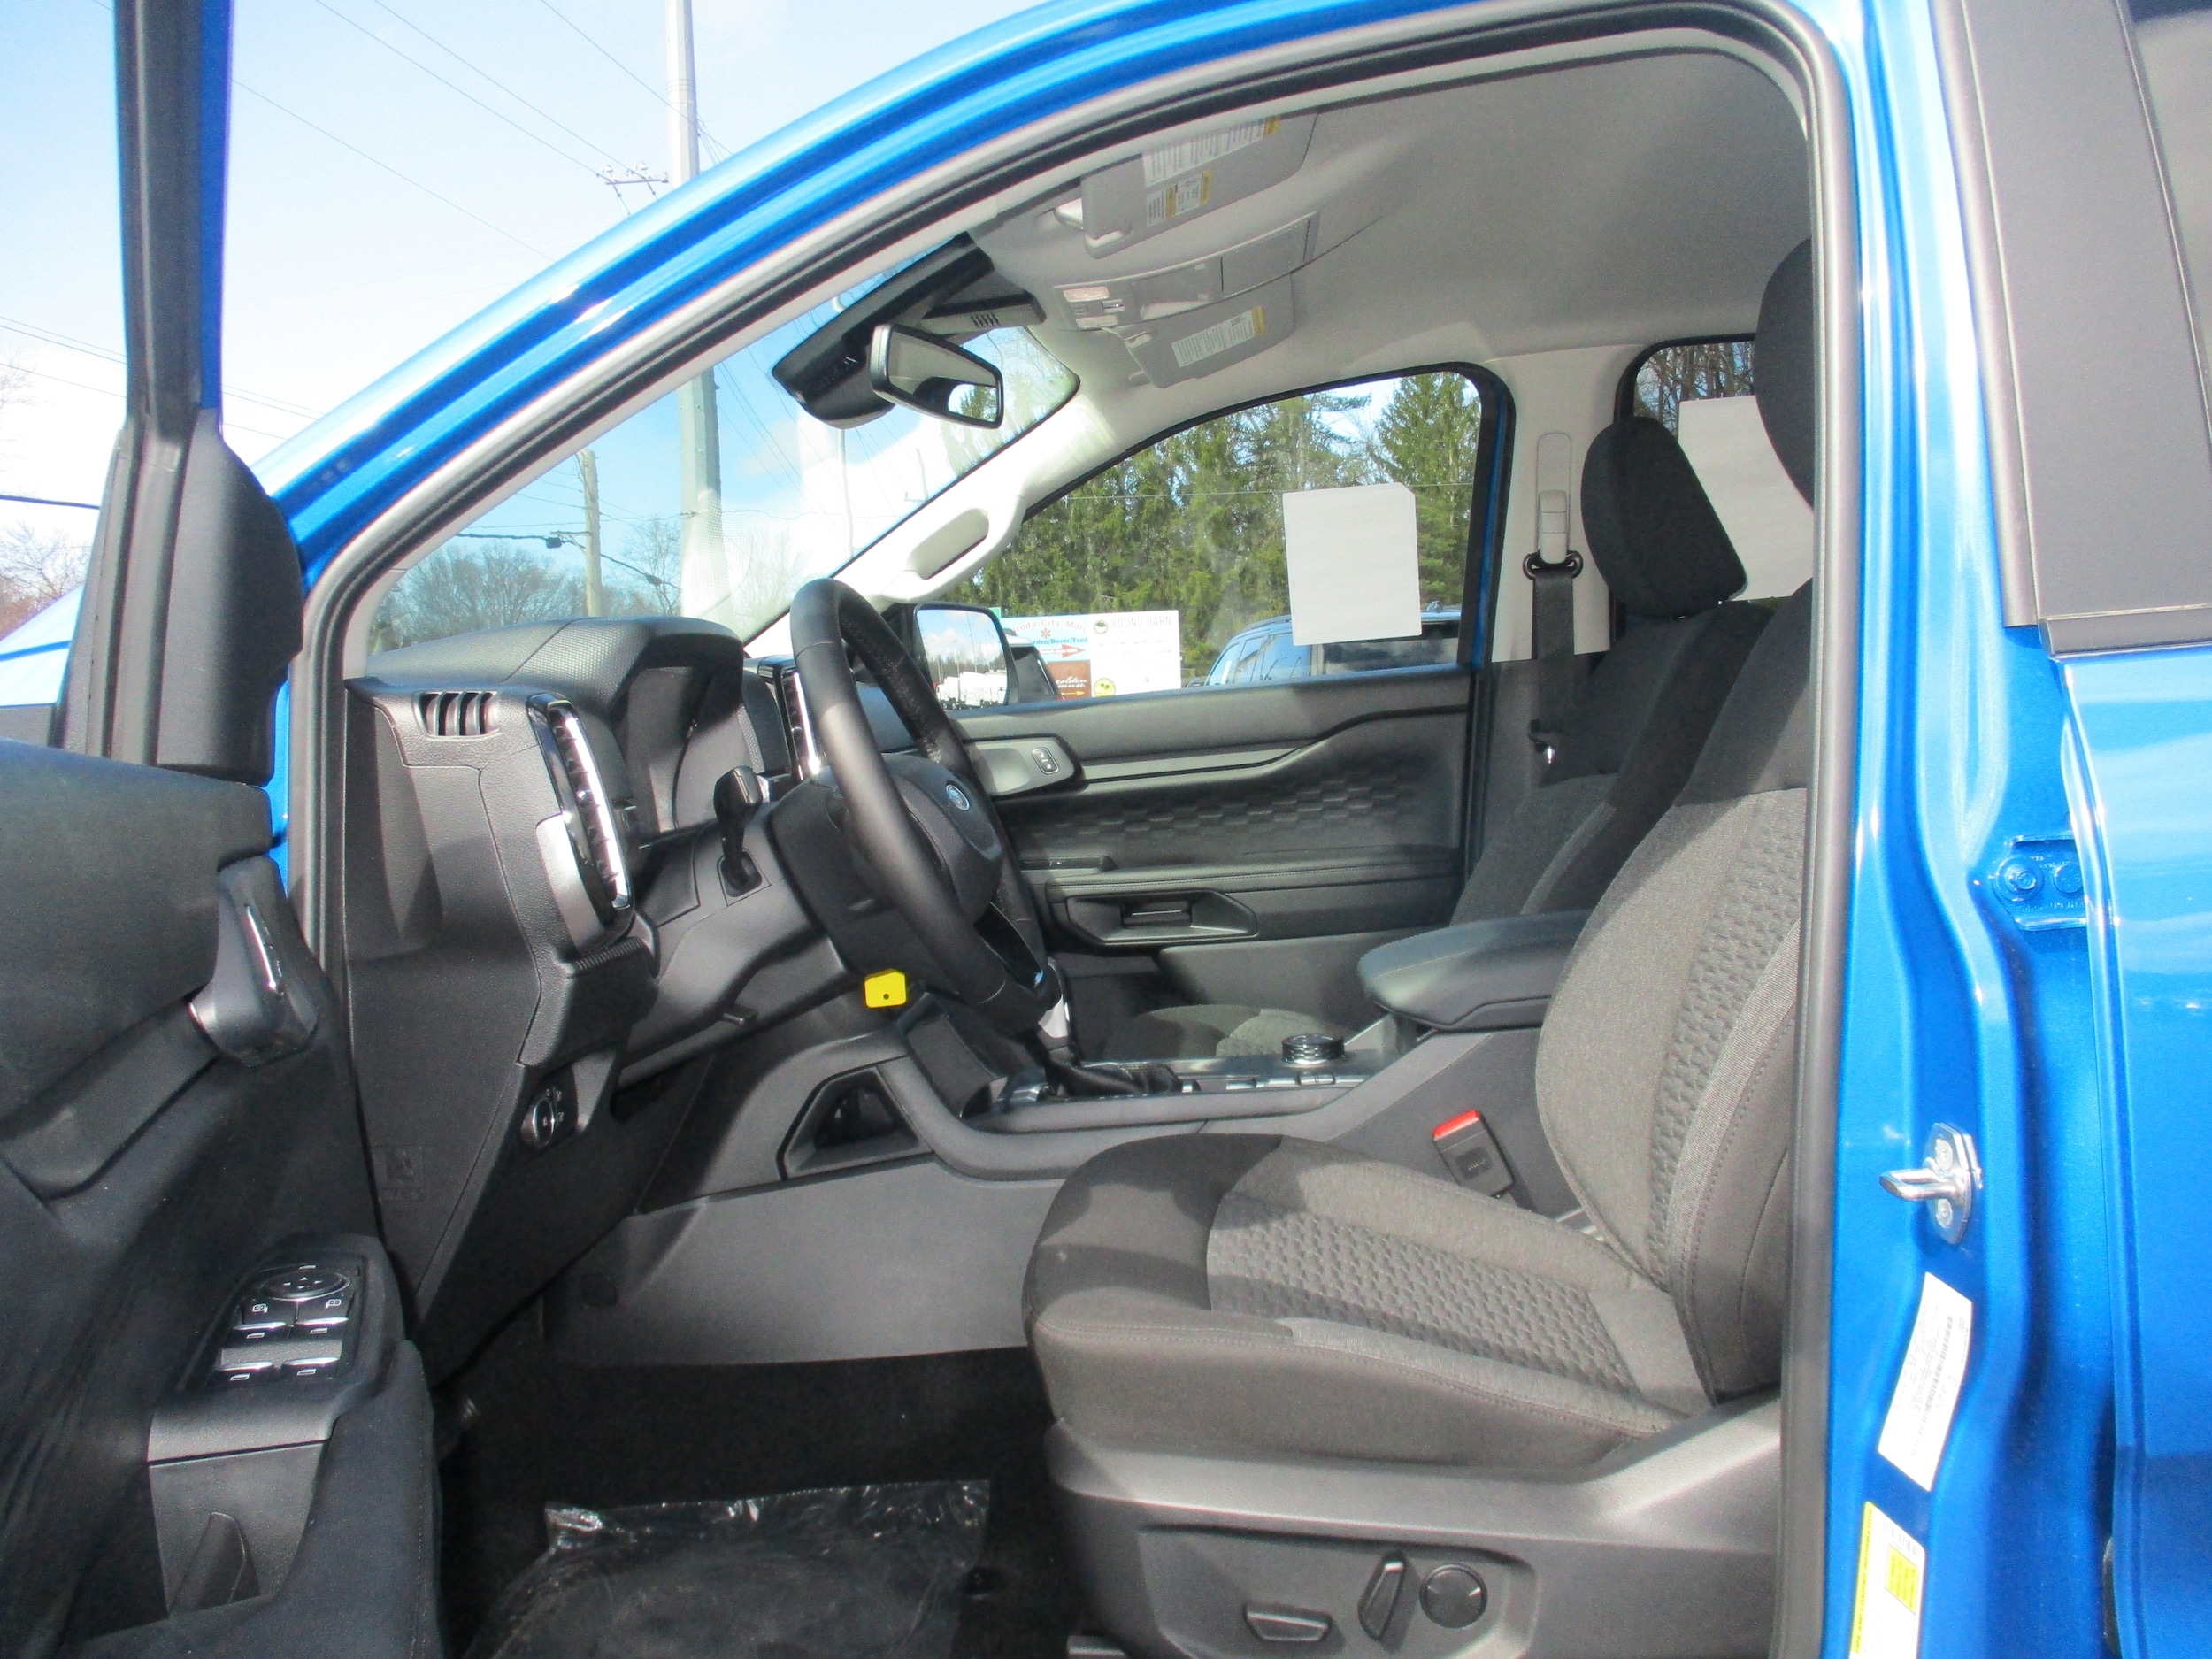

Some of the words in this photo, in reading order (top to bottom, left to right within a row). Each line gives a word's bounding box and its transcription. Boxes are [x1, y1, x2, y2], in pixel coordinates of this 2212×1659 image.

[1065, 620, 1087, 633] Mills
[1111, 617, 1142, 628] ROUND
[1147, 615, 1171, 626] BARN
